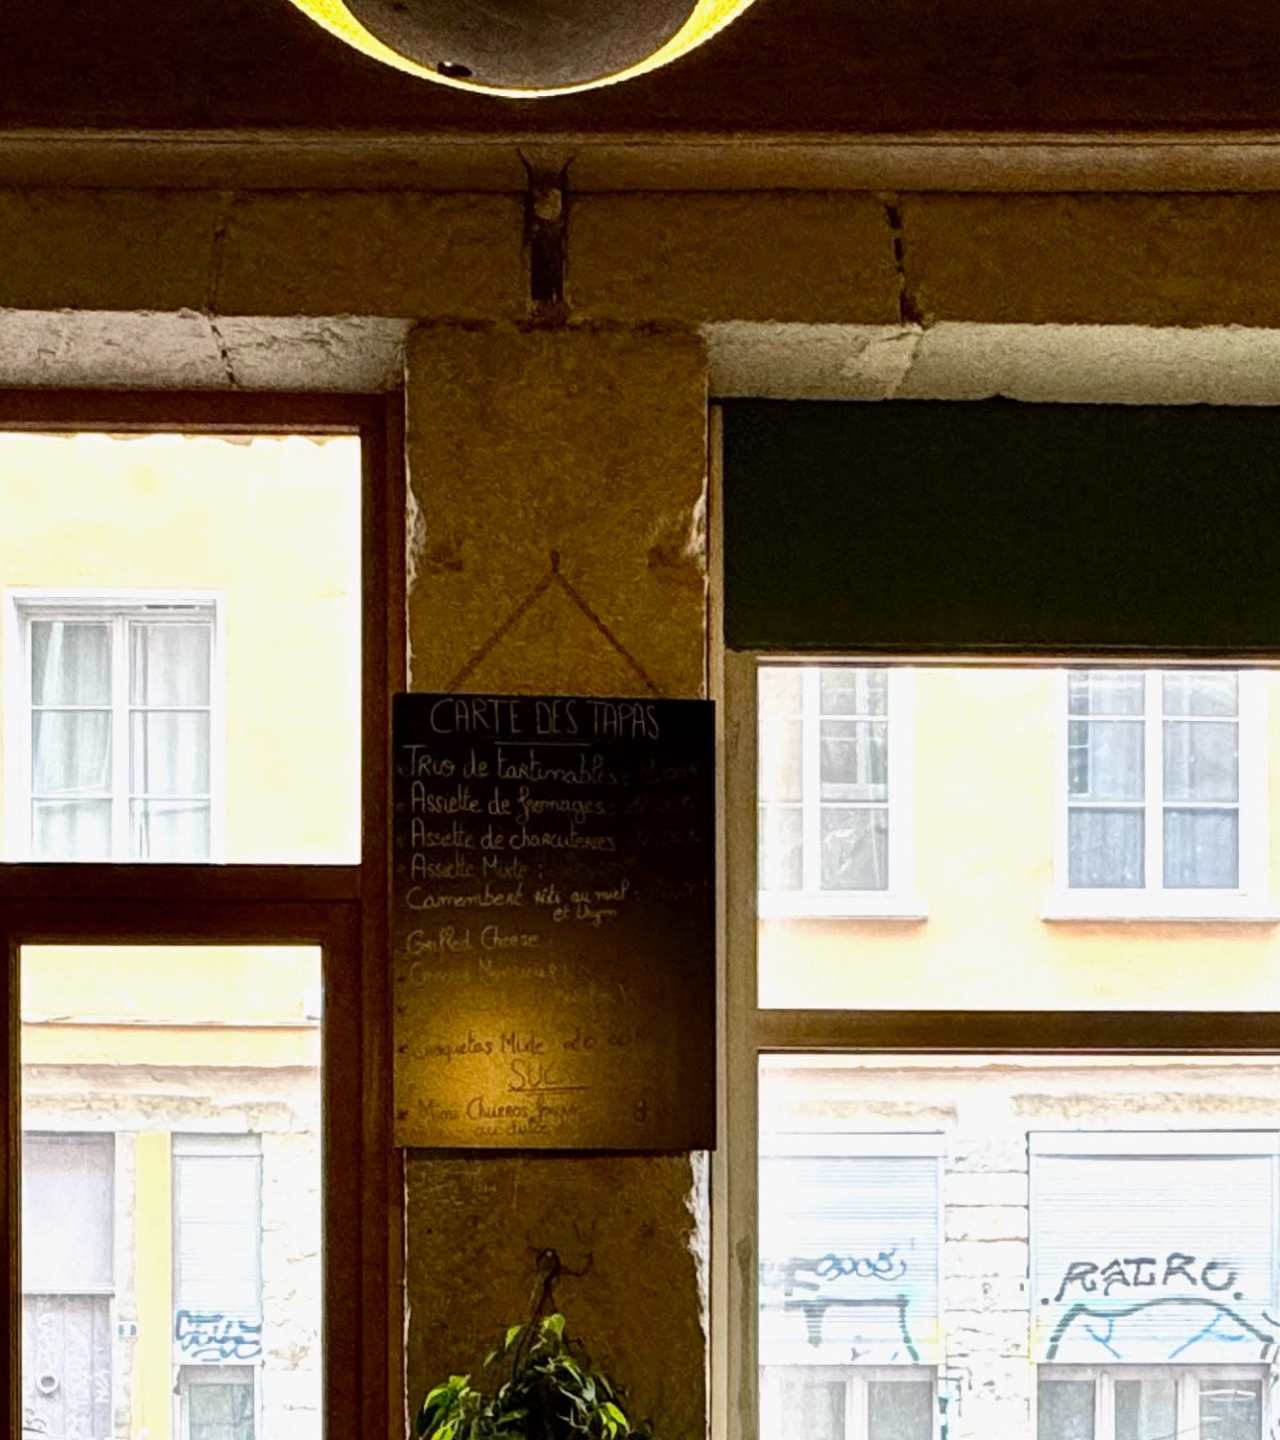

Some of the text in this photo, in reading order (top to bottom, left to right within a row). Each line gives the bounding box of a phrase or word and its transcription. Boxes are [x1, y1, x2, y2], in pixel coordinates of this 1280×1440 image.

[428, 697, 661, 741] CARTE DES TAPAS
[463, 747, 490, 778] de
[487, 786, 512, 815] de
[480, 823, 505, 850] de
[552, 906, 571, 922] et
